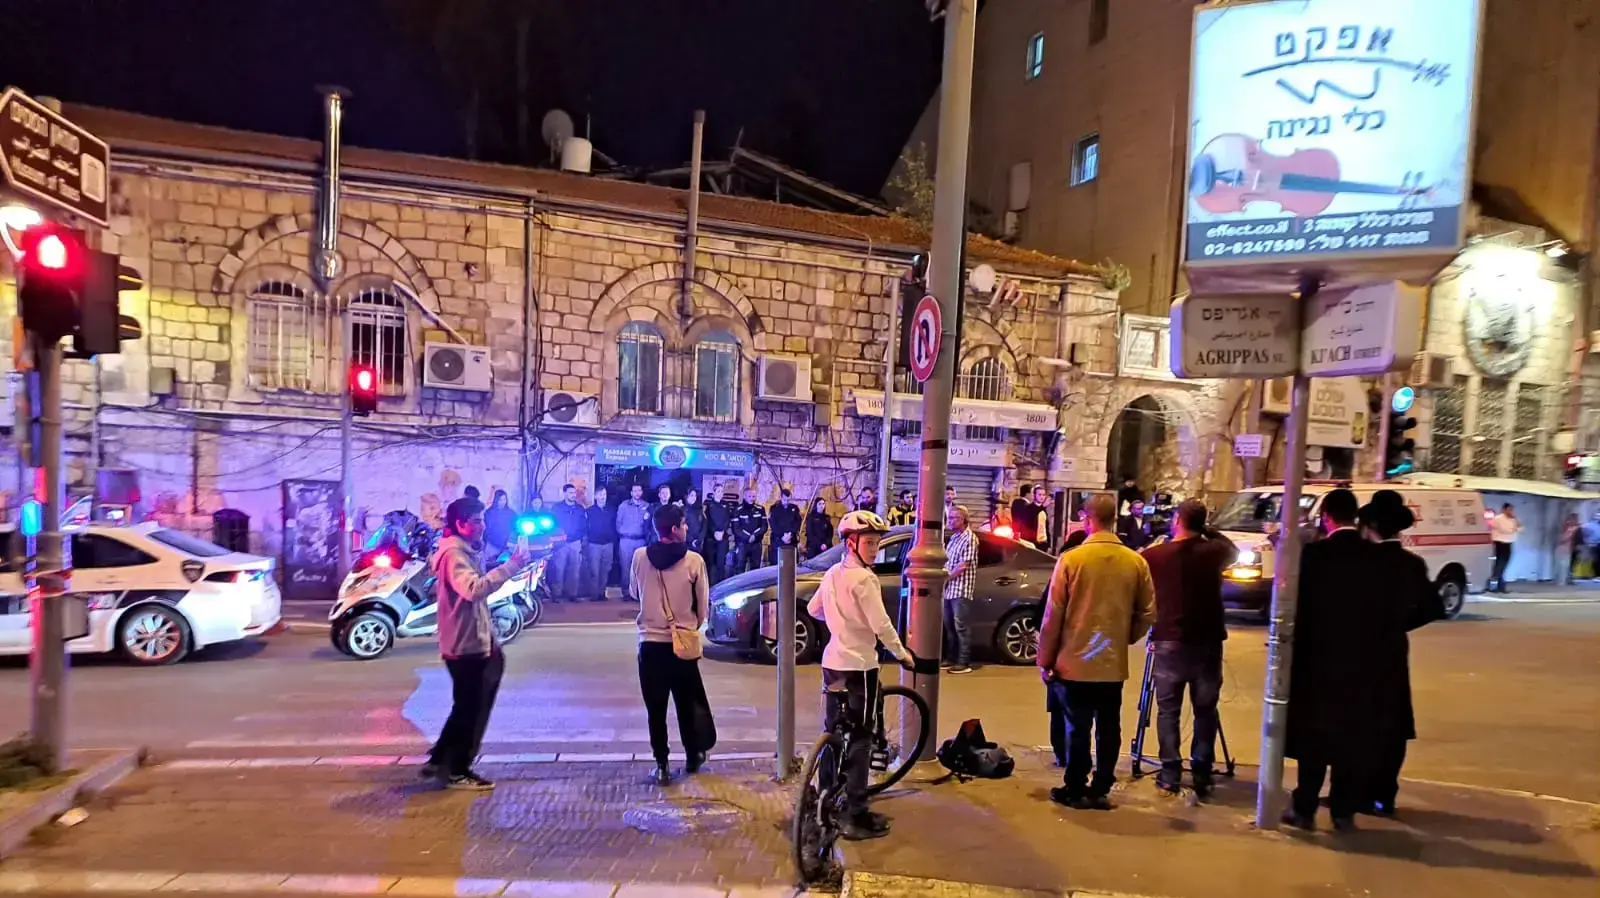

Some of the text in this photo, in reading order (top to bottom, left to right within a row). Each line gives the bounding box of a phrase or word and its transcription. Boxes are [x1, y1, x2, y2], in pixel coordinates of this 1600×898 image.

[1274, 24, 1394, 59] אפקט
[1266, 106, 1386, 141] כלי נגינה
[1206, 219, 1290, 238] effect.co.il
[1303, 219, 1314, 233] 3
[1202, 307, 1260, 322] אגריפס
[1195, 348, 1270, 366] AGRIPPAS
[867, 399, 885, 409] 180
[1026, 413, 1047, 424] 1800
[603, 448, 631, 457] MASSAGE
